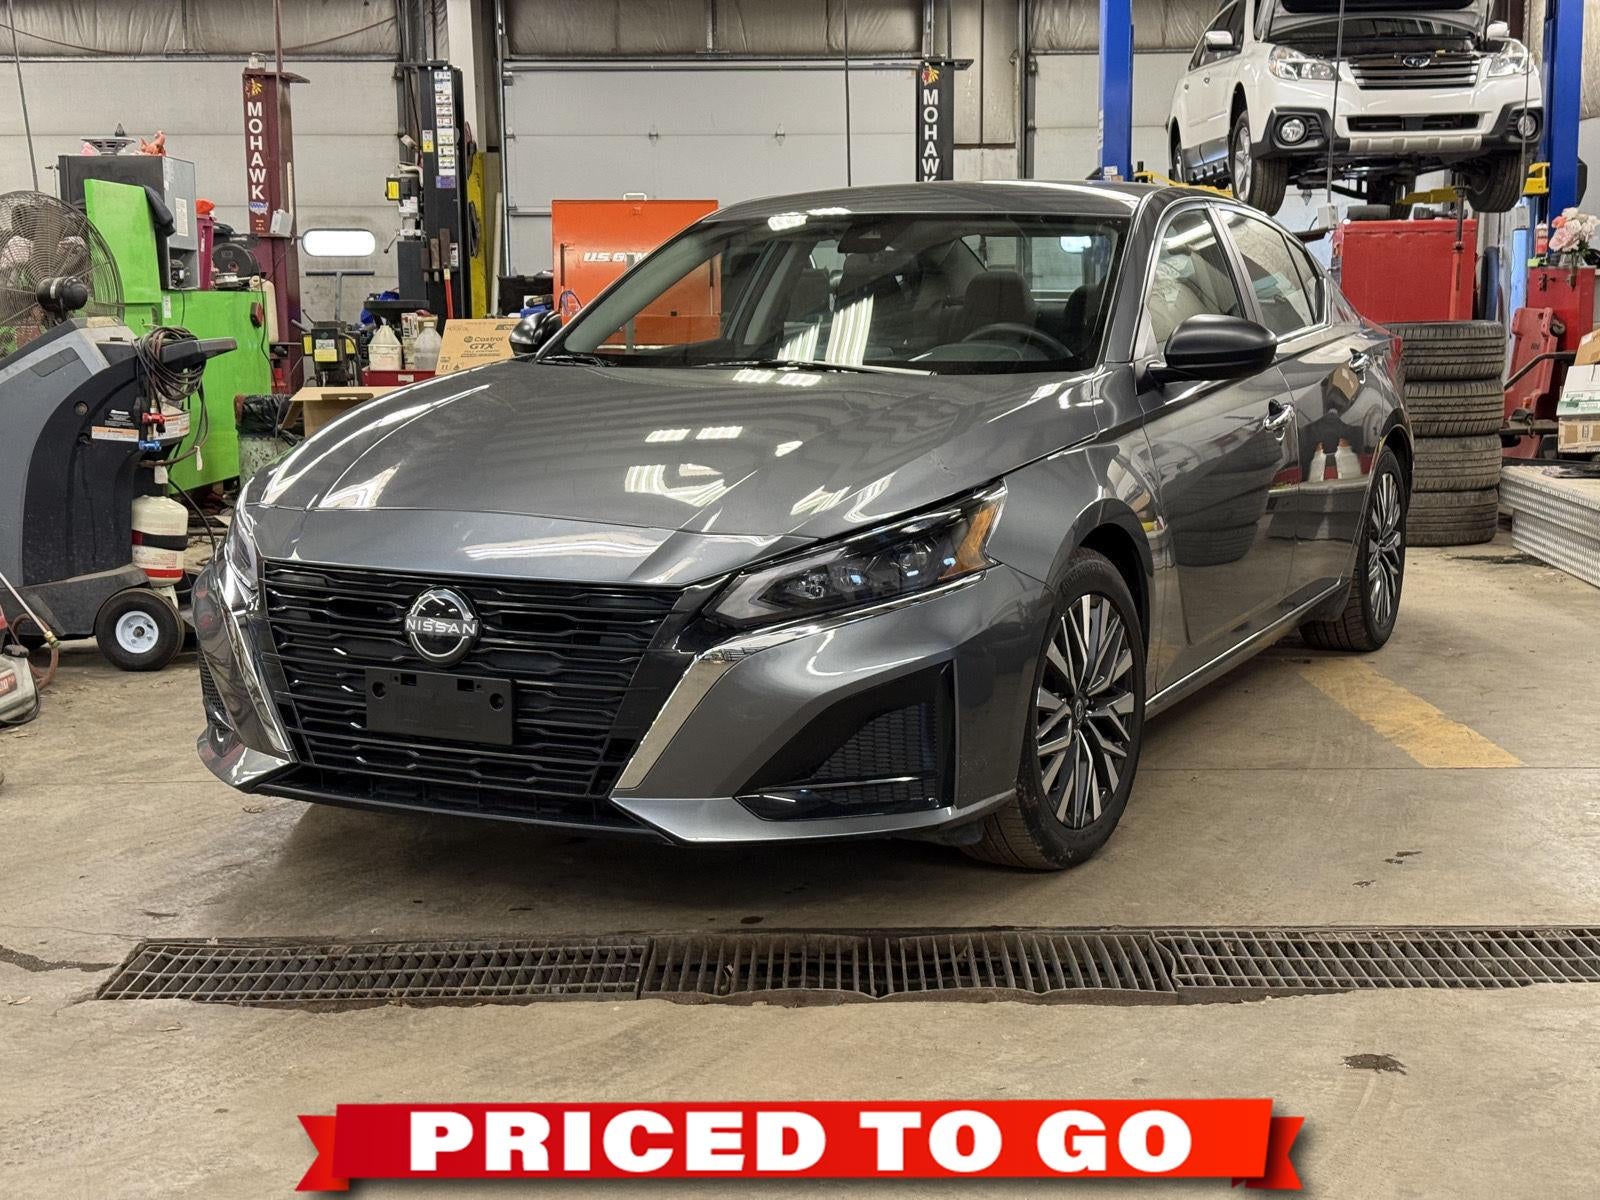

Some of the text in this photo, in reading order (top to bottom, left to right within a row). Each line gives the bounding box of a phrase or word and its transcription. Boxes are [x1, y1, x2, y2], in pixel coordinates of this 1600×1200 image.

[247, 101, 266, 200] MOHAWK
[469, 342, 496, 350] GTX
[406, 618, 476, 634] NISSAN
